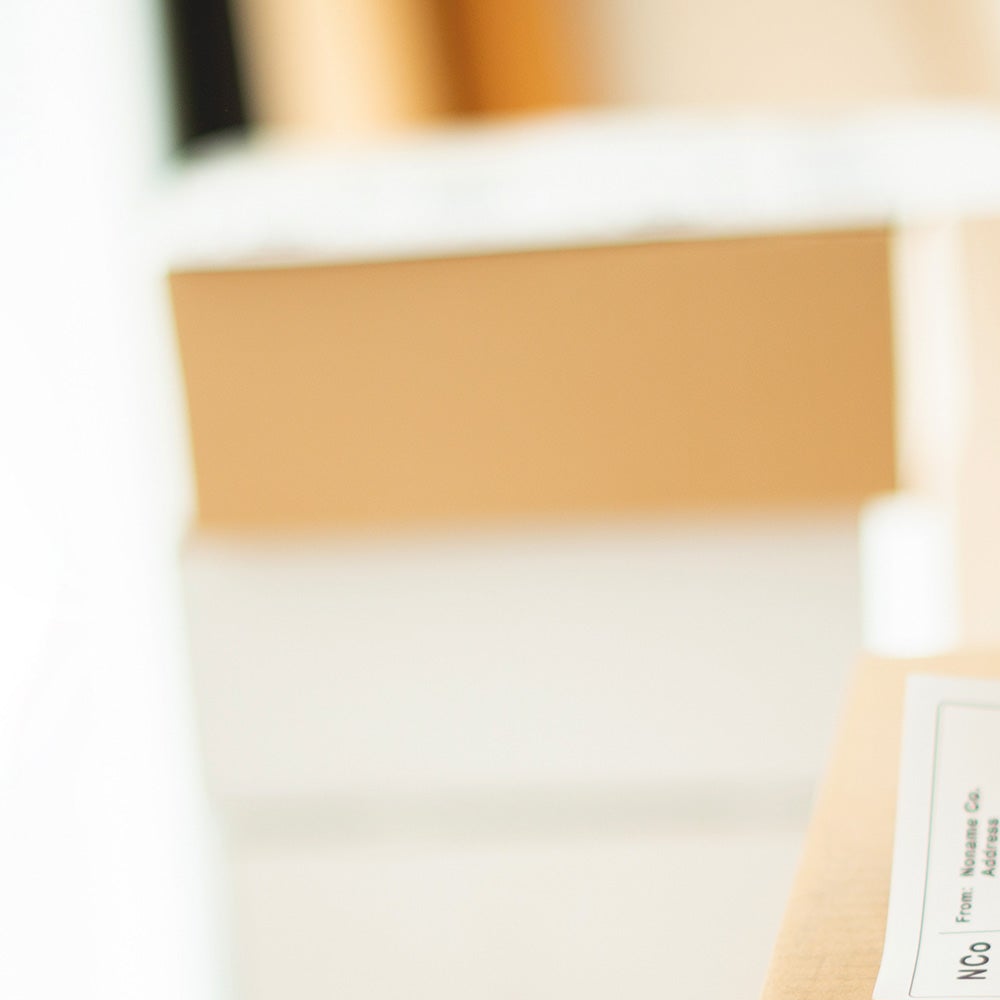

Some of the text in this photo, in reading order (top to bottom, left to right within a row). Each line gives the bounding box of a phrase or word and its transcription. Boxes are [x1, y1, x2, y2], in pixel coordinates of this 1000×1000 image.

[955, 788, 981, 923] From: Noname Co.
[982, 818, 999, 877] Address
[957, 941, 991, 980] NCo
